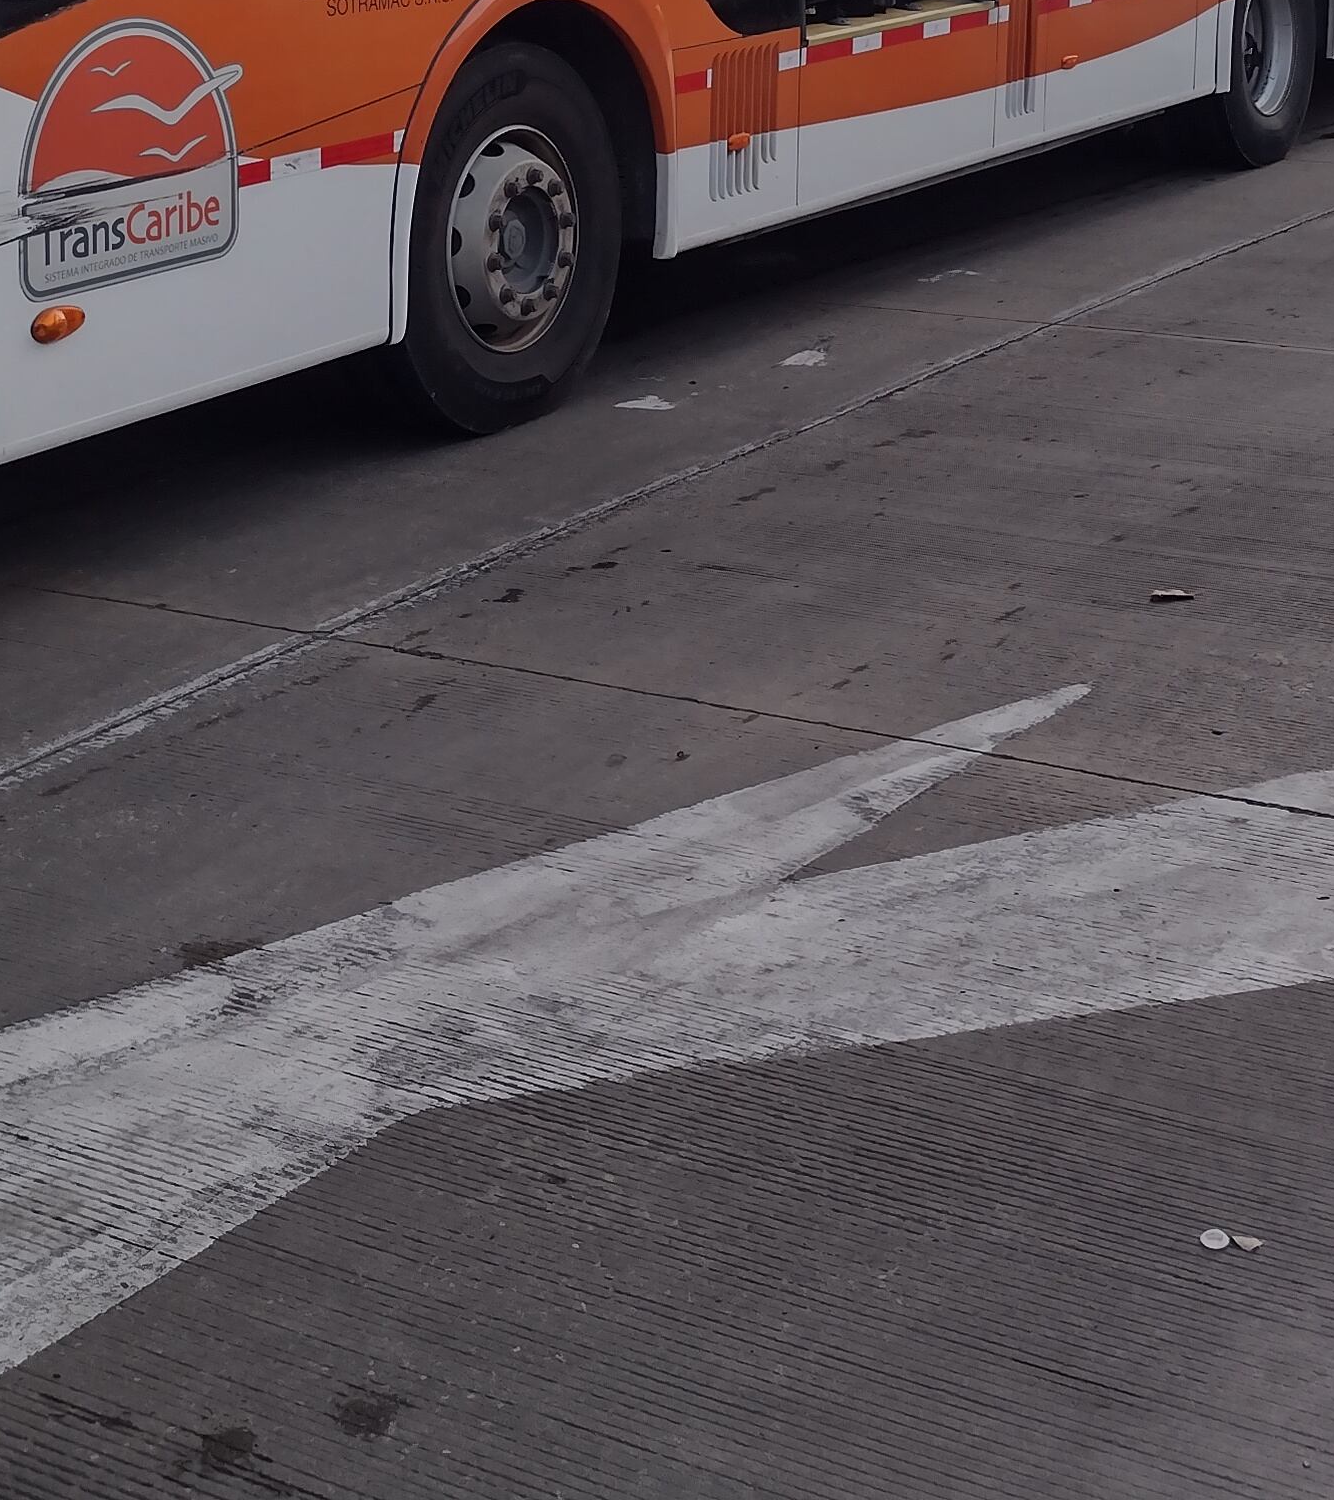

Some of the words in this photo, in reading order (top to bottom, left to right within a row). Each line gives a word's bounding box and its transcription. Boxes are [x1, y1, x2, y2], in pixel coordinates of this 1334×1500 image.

[43, 190, 221, 266] TransCaribe
[44, 268, 80, 284] SISTEMA
[80, 254, 127, 276] INTEGRADO
[127, 251, 138, 264] DE
[139, 240, 189, 260] TRANSPORTE
[189, 233, 220, 251] MASIVO
